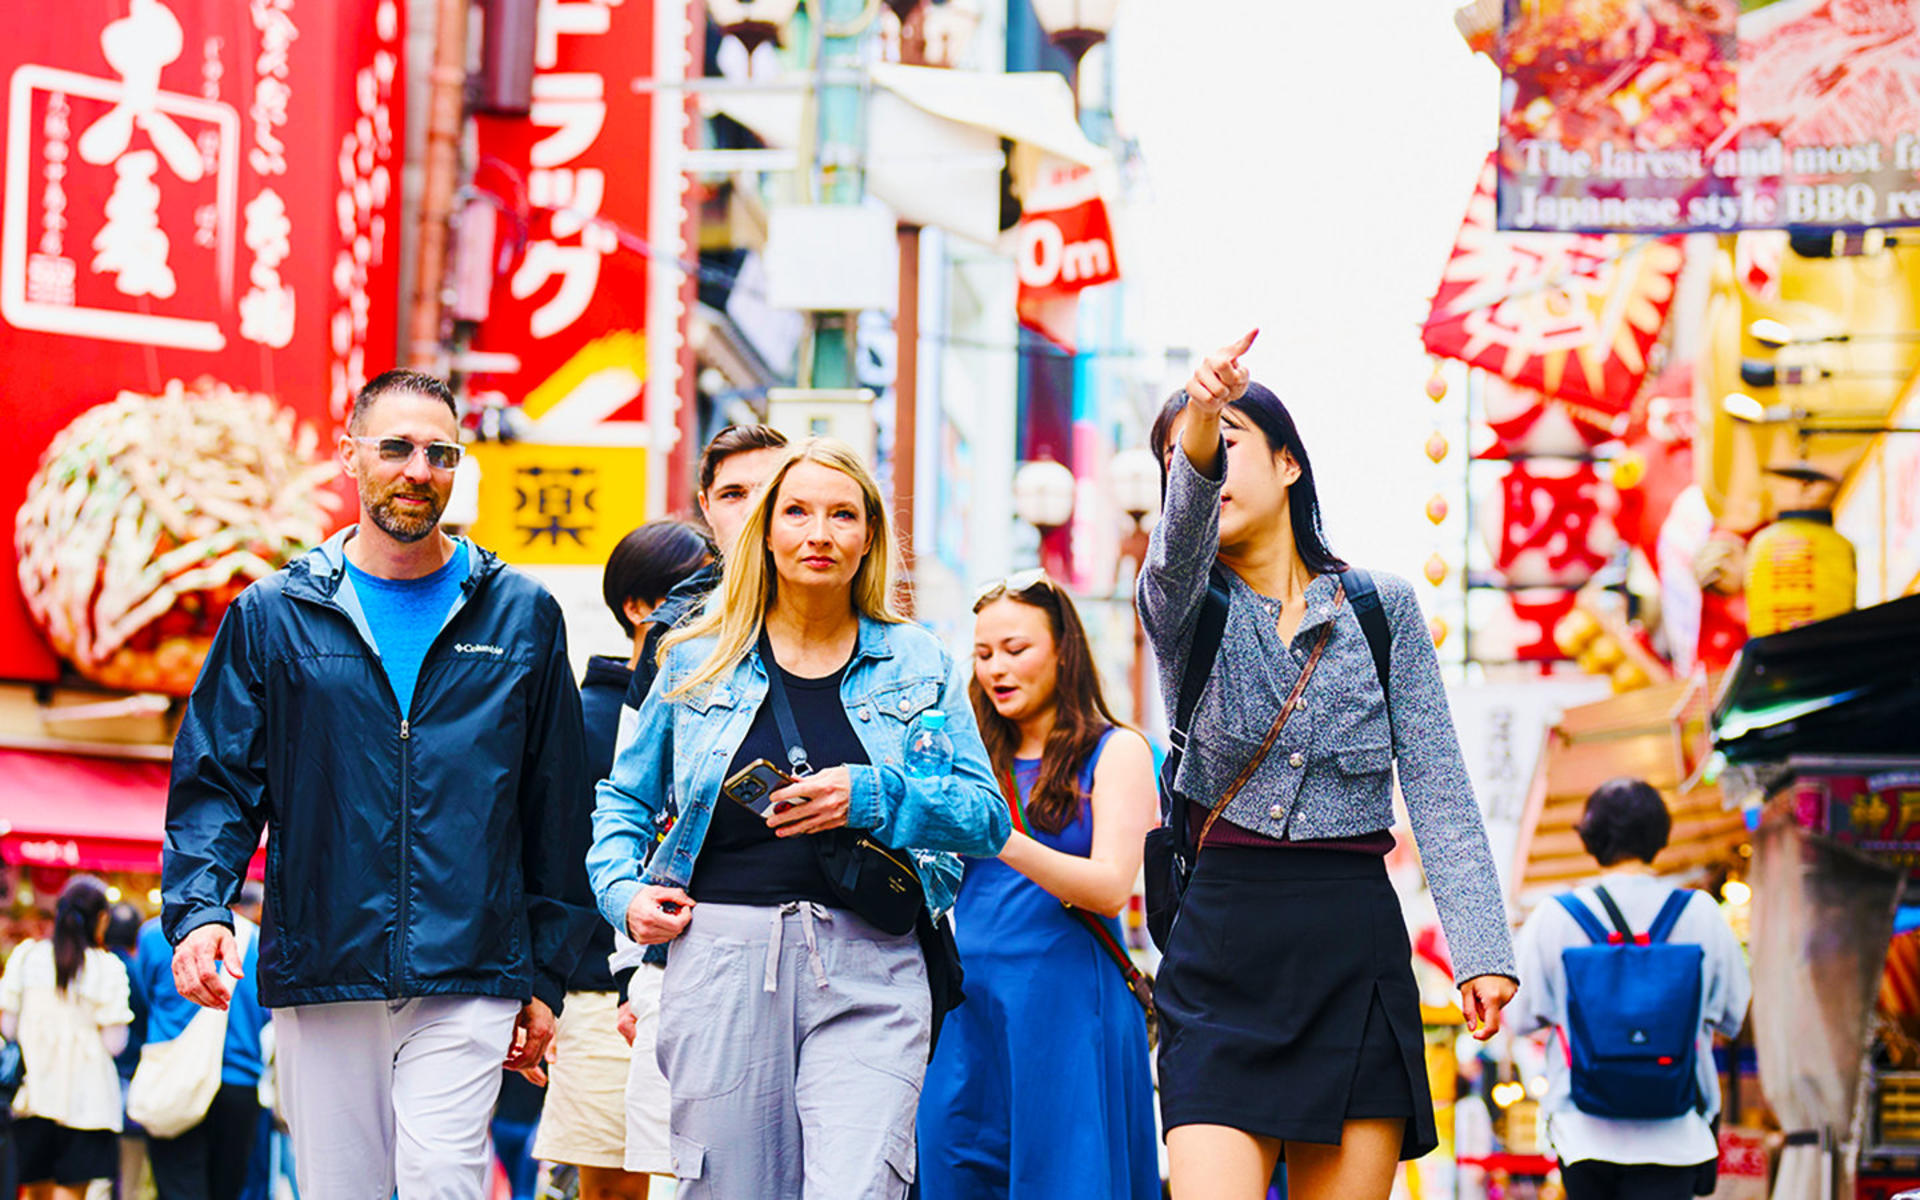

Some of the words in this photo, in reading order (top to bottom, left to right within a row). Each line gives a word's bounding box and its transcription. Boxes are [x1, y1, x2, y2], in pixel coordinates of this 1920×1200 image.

[1518, 140, 1590, 177] The
[1713, 138, 1782, 177] and
[1794, 140, 1881, 173] most
[1515, 186, 1680, 229] Japanese
[1687, 183, 1777, 229] style
[1787, 183, 1877, 225] BBQ
[514, 465, 597, 549] 薬
